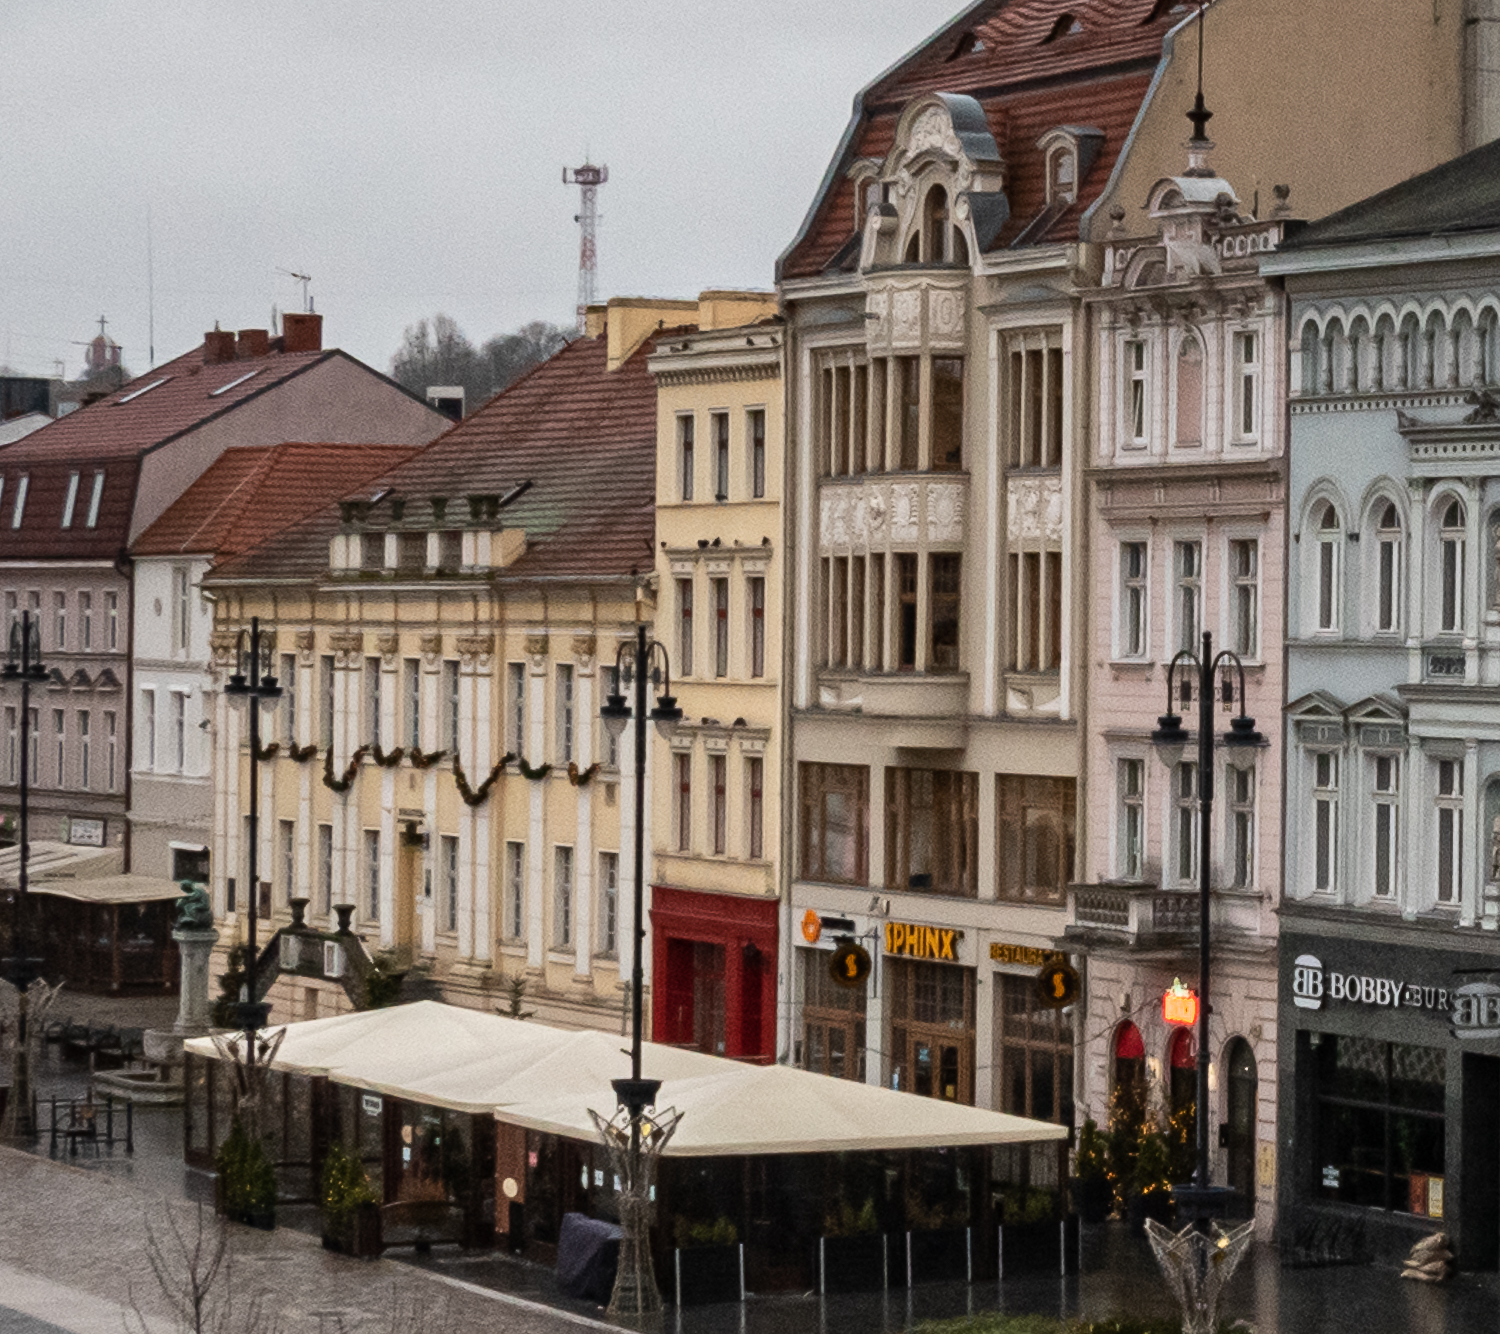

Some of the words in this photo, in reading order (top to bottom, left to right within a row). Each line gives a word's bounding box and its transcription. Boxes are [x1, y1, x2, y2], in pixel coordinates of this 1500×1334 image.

[885, 922, 955, 960] SPHINX
[1330, 972, 1403, 1008] BOBBY
[1404, 984, 1457, 1011] BUR
